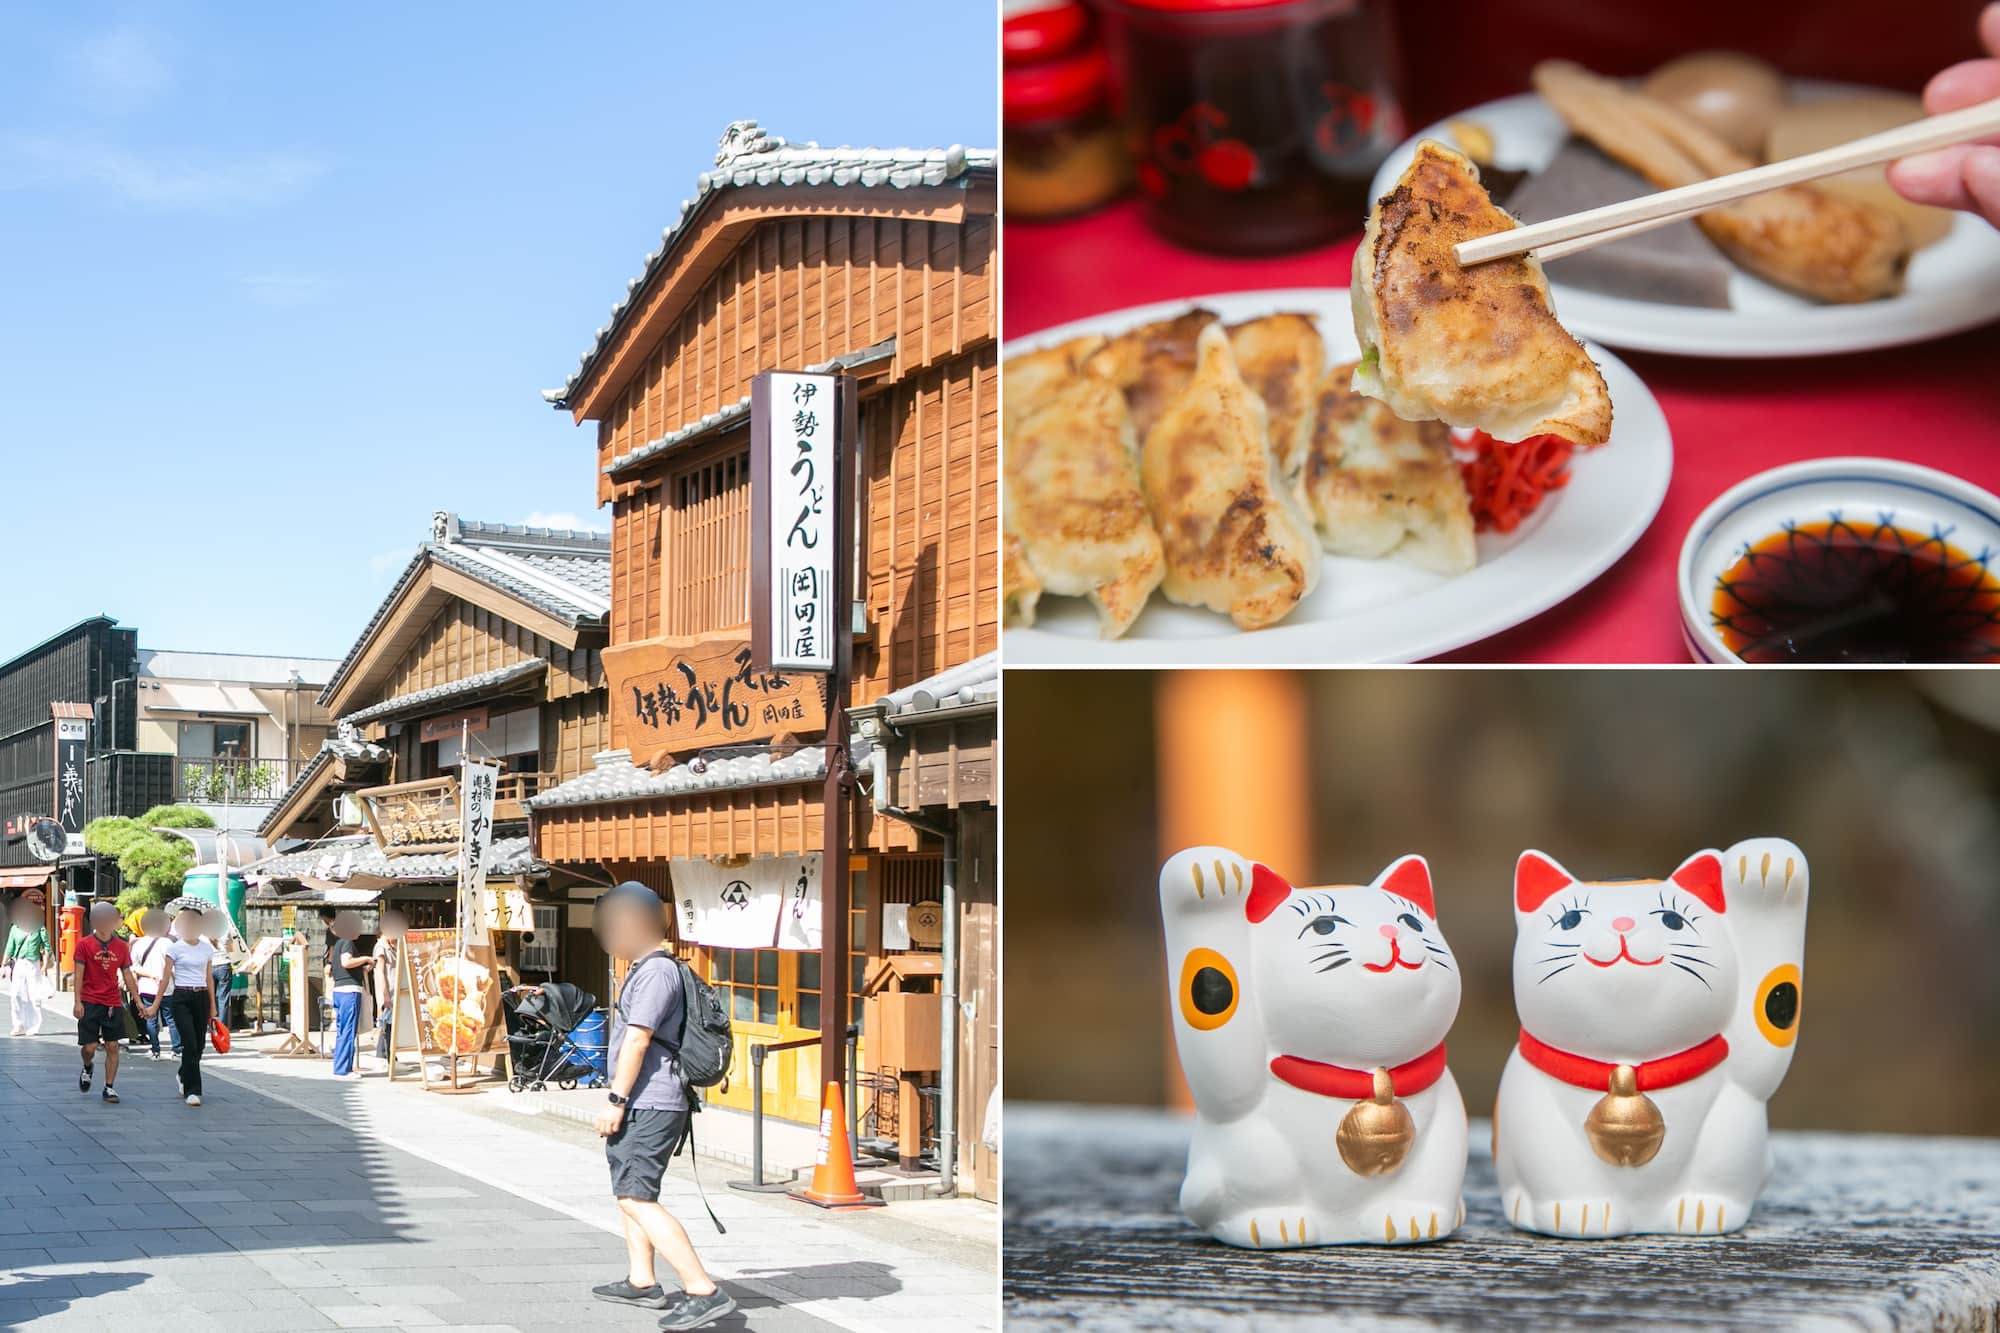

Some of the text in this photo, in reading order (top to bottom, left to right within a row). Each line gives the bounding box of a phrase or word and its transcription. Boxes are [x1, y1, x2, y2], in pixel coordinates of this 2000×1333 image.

[787, 382, 822, 658] 伊勢うどん 岡田屋
[633, 661, 749, 730] 伊勢うどん
[763, 699, 805, 724] 岡田屋
[484, 904, 525, 926] フライ
